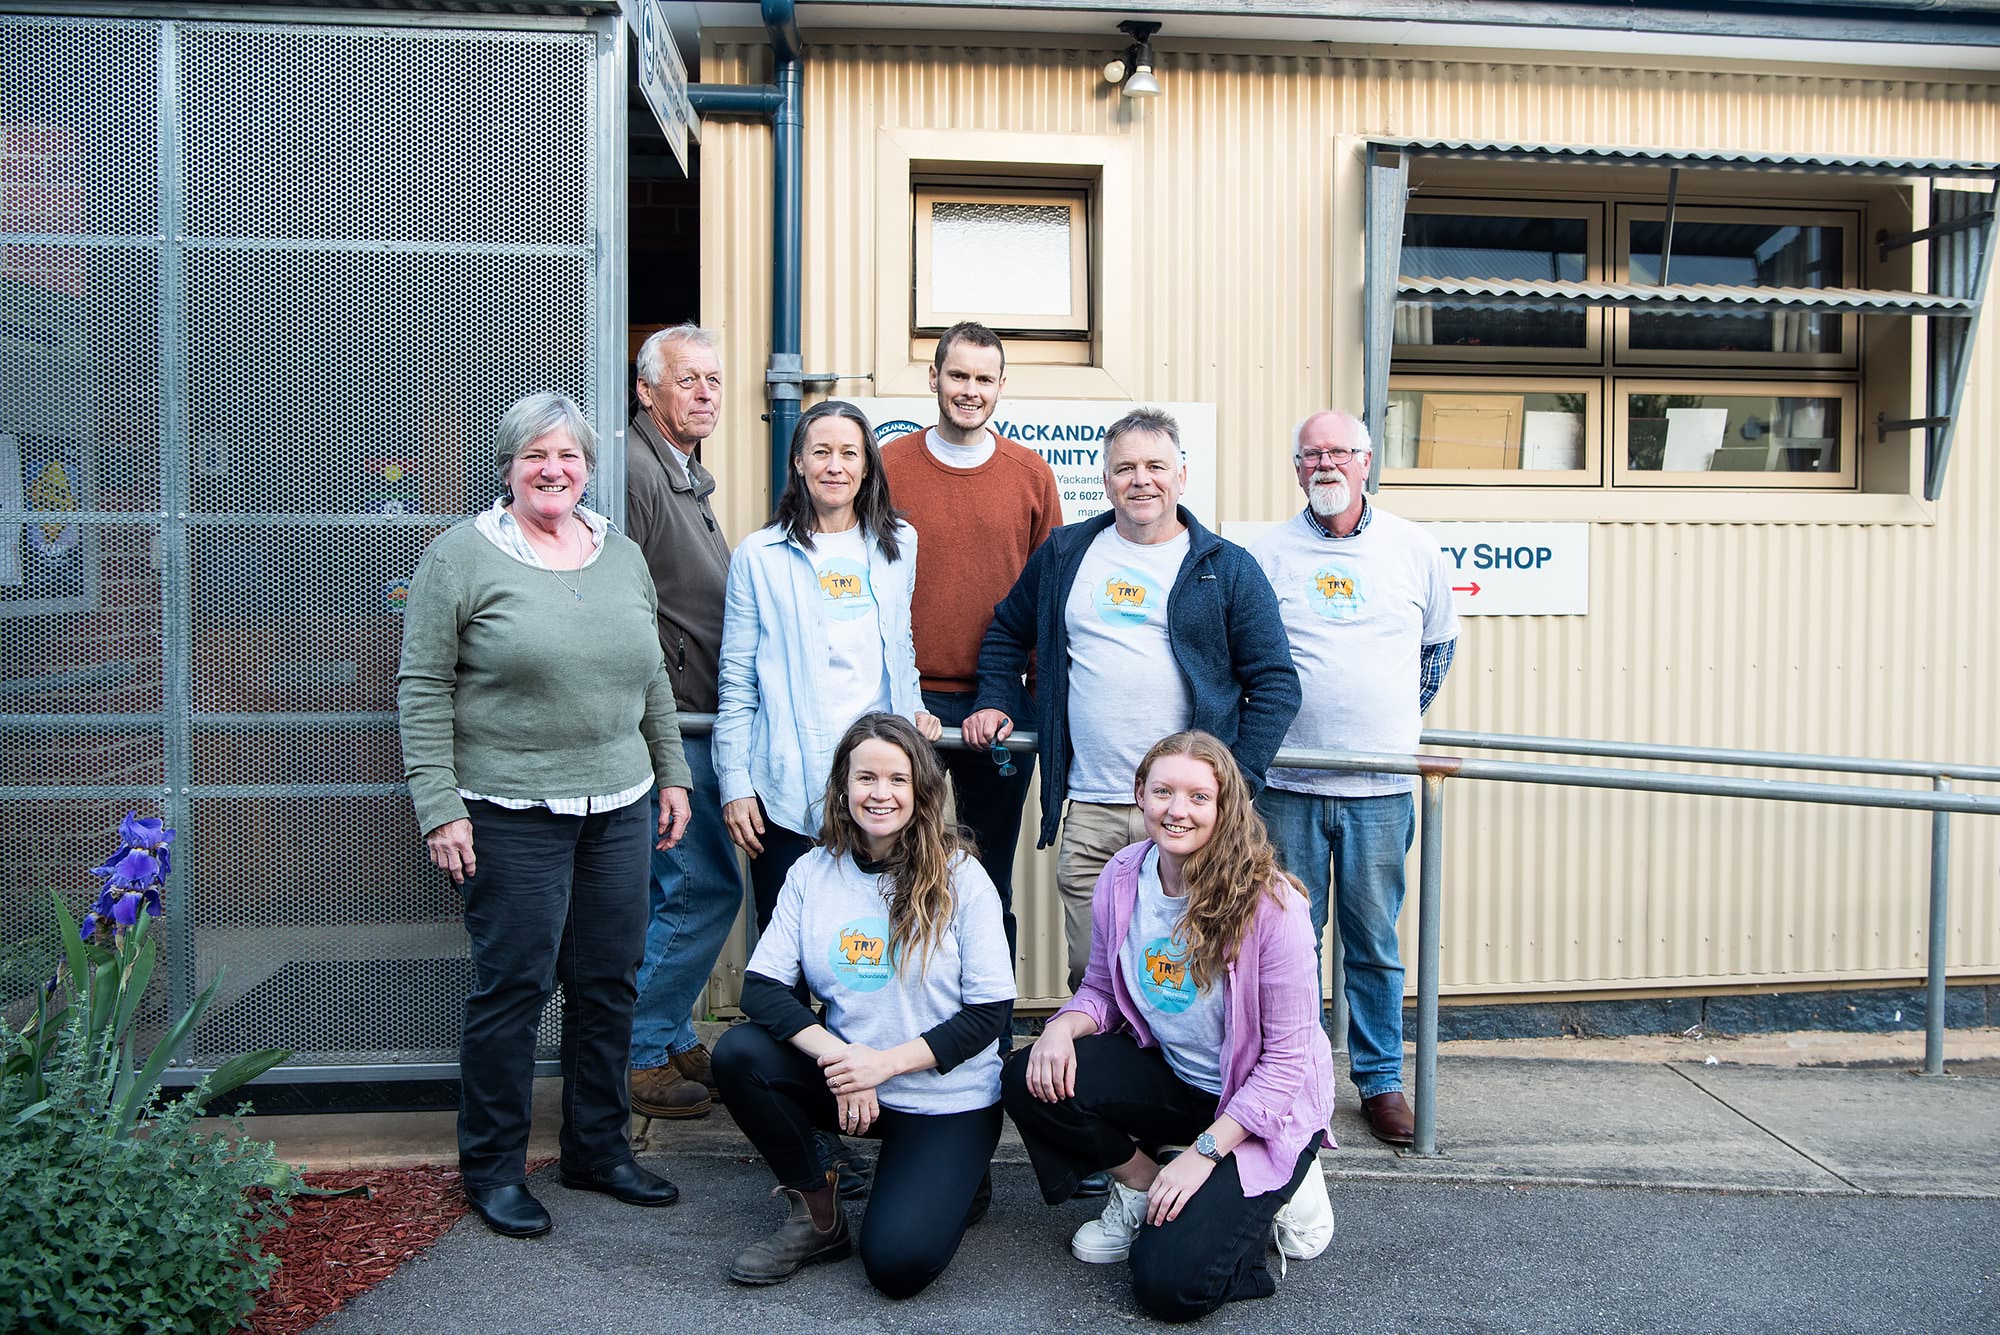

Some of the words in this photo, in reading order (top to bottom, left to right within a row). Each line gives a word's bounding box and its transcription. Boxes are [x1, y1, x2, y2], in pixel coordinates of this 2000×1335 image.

[1033, 449, 1099, 466] UNITY
[1063, 491, 1077, 501] 02
[1079, 491, 1105, 501] 6027
[1473, 543, 1553, 569] SHOP
[832, 578, 853, 588] TRY
[1327, 580, 1347, 590] TRY
[1118, 587, 1139, 597] TRY
[854, 940, 877, 951] TRY
